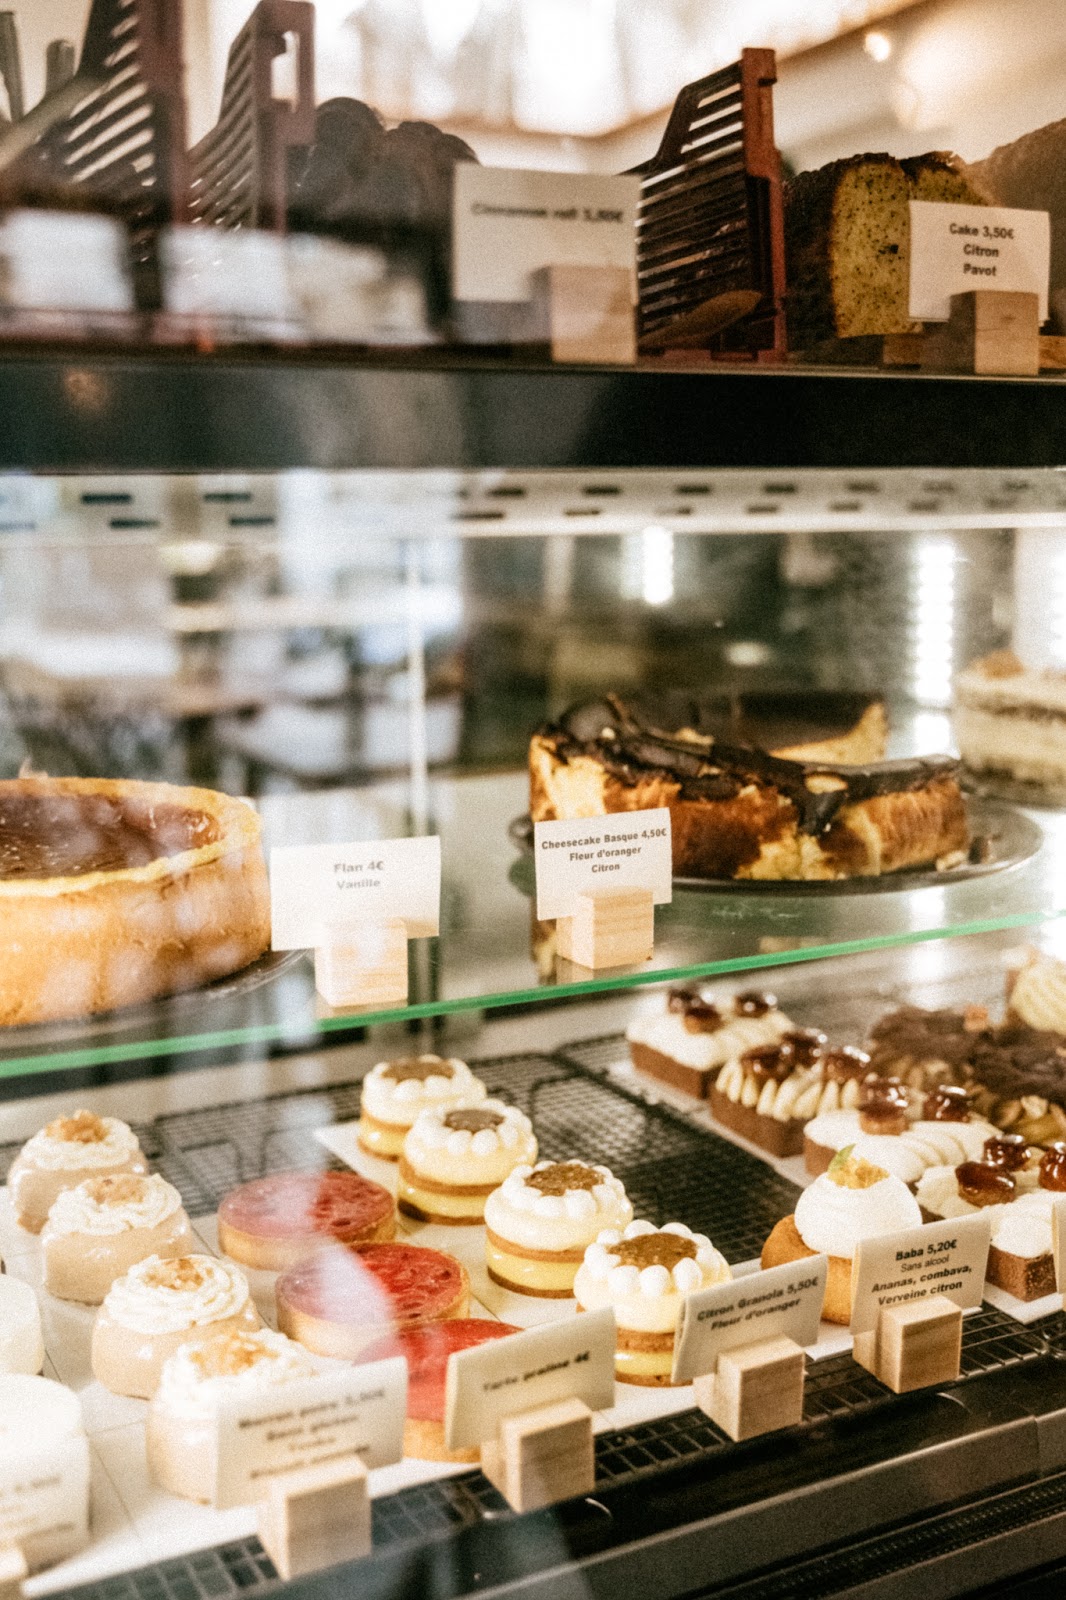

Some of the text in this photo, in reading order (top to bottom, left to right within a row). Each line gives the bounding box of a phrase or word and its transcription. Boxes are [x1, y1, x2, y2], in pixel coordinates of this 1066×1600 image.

[949, 222, 1014, 240] Cake 3,50€
[963, 243, 999, 257] Citron
[963, 263, 997, 277] Pavot
[541, 828, 667, 850] Cheesecake Basque 4,50€
[569, 847, 642, 861] Fleur d'oranger
[333, 863, 364, 873] Flan
[591, 863, 620, 873] Citron
[336, 879, 380, 890] Vanille
[895, 1239, 957, 1261] Baba 5,20€
[901, 1254, 950, 1273] Sans alcool
[871, 1264, 972, 1293] Ananas, combava,
[878, 1280, 963, 1306] Verveine citron
[697, 1304, 734, 1322] Citron
